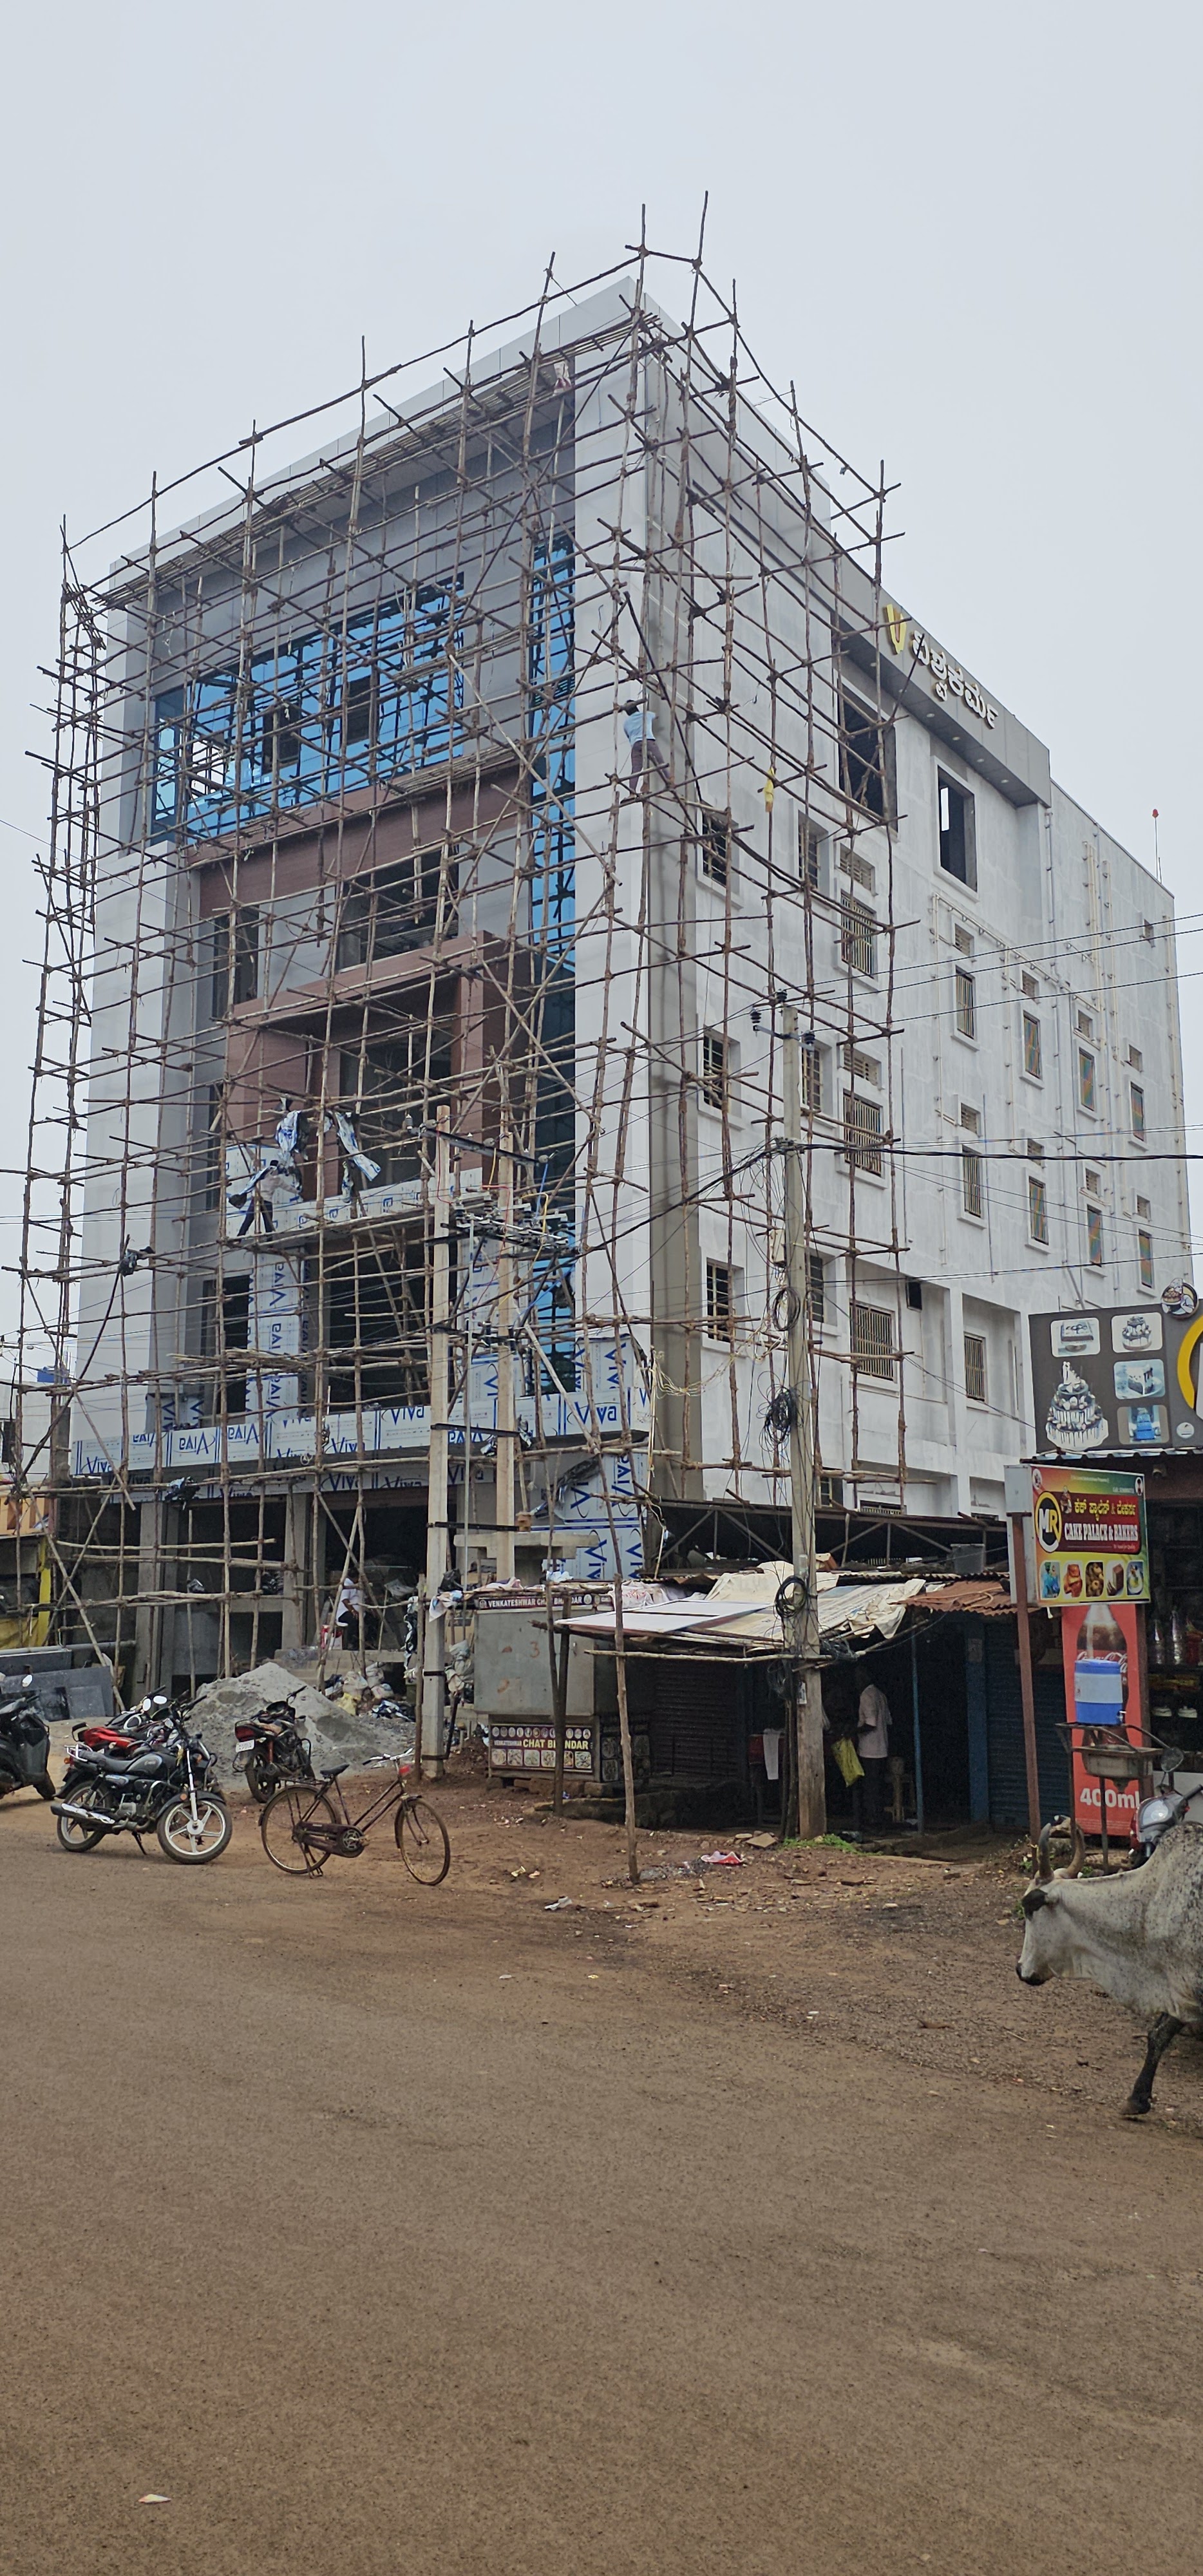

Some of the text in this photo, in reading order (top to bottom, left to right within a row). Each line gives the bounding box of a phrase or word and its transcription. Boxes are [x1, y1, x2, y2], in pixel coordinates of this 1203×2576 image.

[179, 1431, 209, 1455] Viva
[1065, 1522, 1138, 1541] CAKE PALACE & BAKERS
[523, 1739, 545, 1748] CHAT
[547, 1739, 589, 1750] BNDAR
[1080, 1788, 1140, 1808] 400ml
